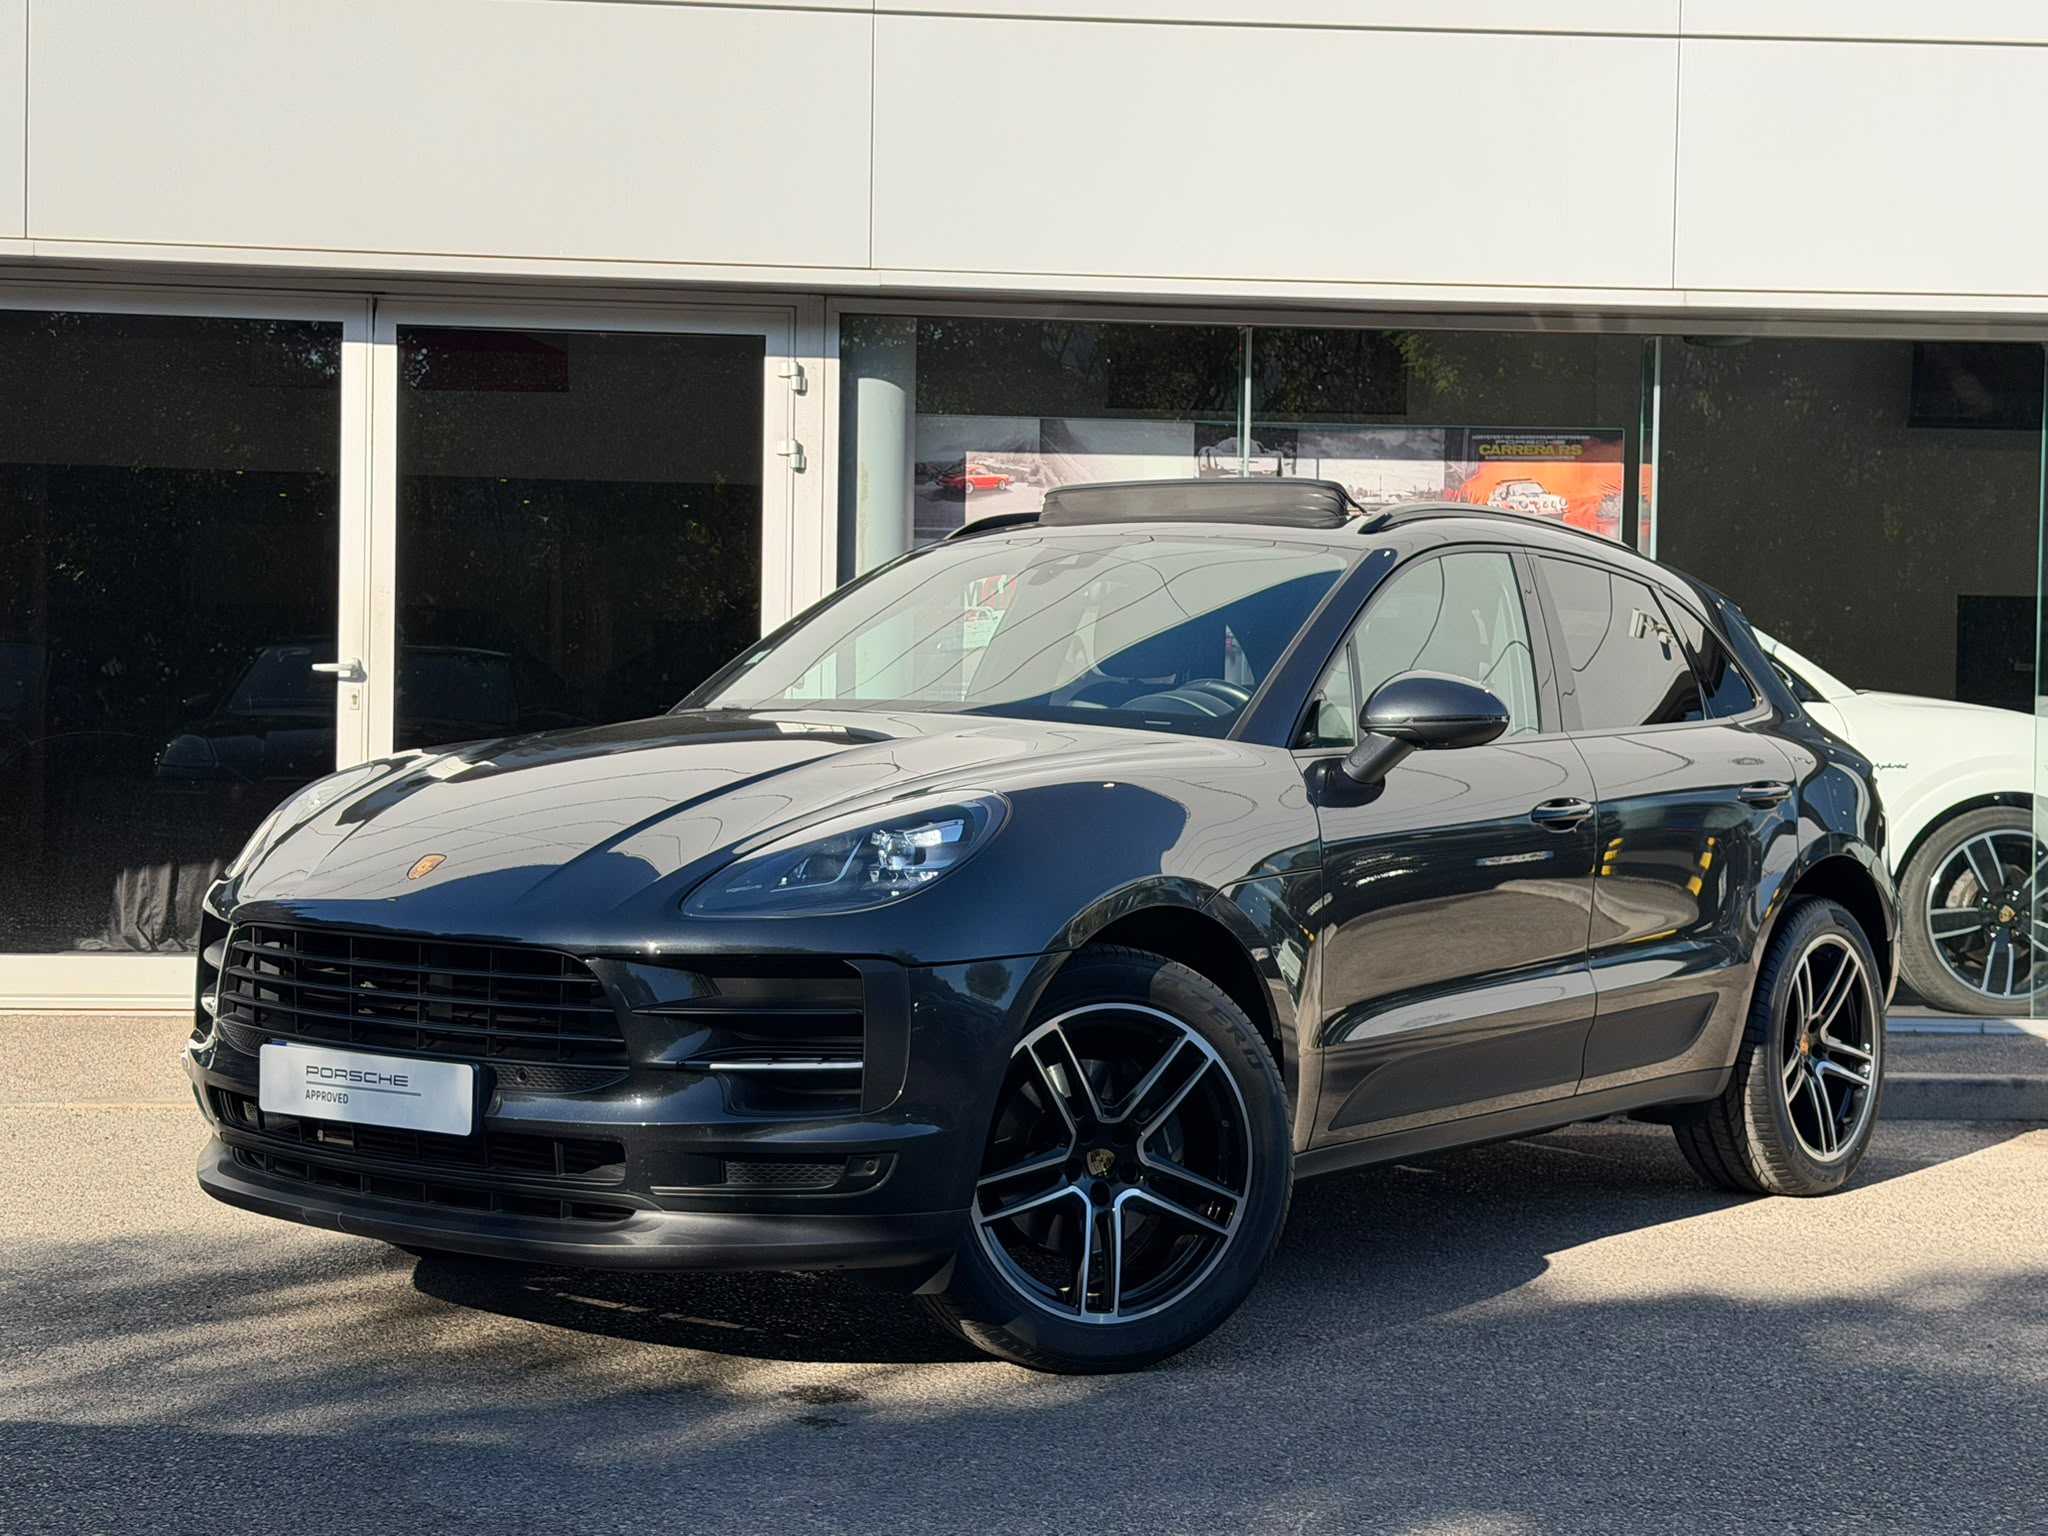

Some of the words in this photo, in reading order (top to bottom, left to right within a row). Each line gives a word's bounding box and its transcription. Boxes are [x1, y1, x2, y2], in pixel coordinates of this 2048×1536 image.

[1479, 444, 1555, 456] CARRERA
[1559, 444, 1583, 456] RS
[305, 1065, 409, 1088] PORSCHE
[304, 1089, 350, 1105] APPROVED
